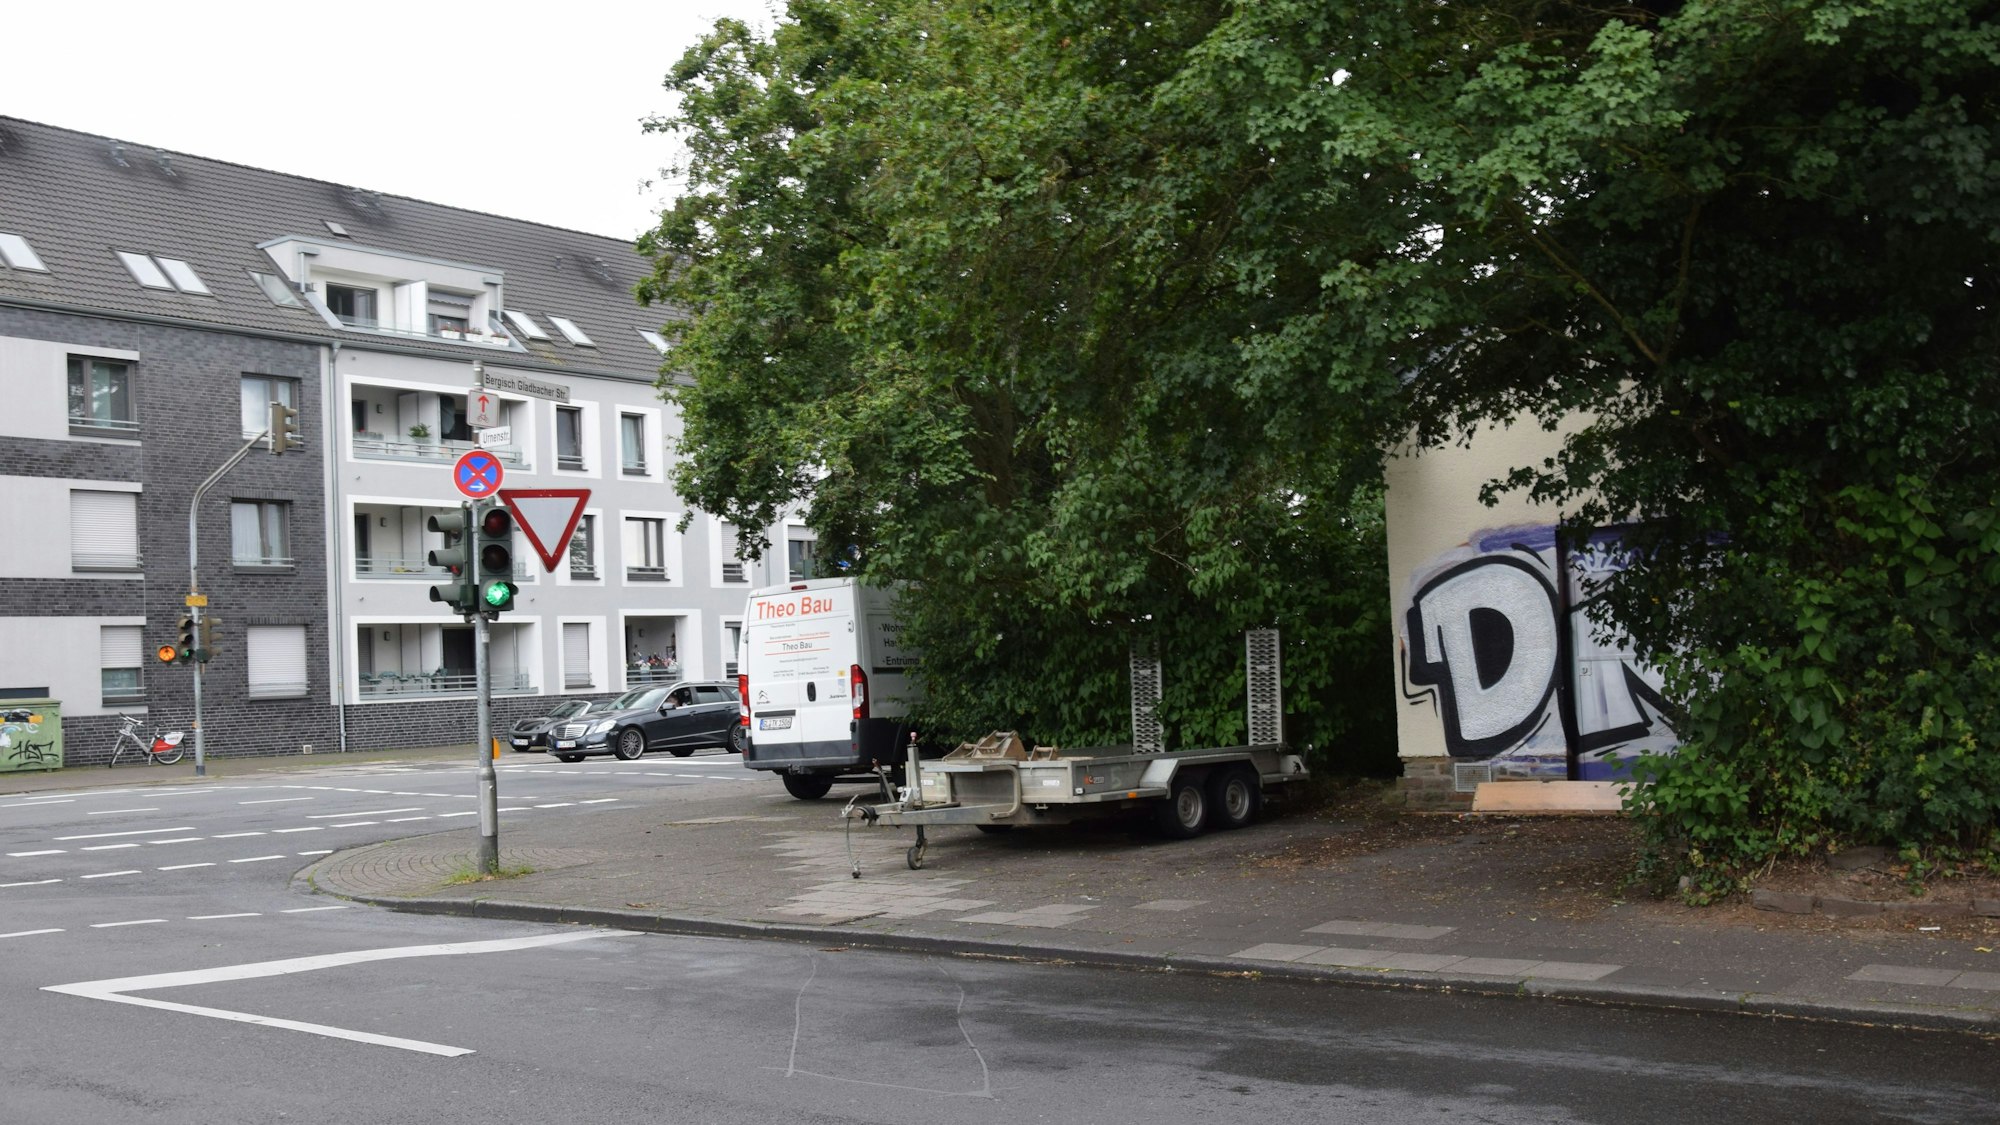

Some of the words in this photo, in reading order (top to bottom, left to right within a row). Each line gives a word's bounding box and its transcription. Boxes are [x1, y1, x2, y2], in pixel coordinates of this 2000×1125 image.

[485, 373, 516, 389] Bergisch
[517, 380, 555, 397] Gladbacher
[556, 388, 567, 399] Str.
[483, 431, 510, 444] Urnenstr.
[757, 601, 795, 620] Theo
[800, 596, 833, 615] Bau
[782, 643, 798, 651] Theo
[799, 641, 813, 650] Bau
